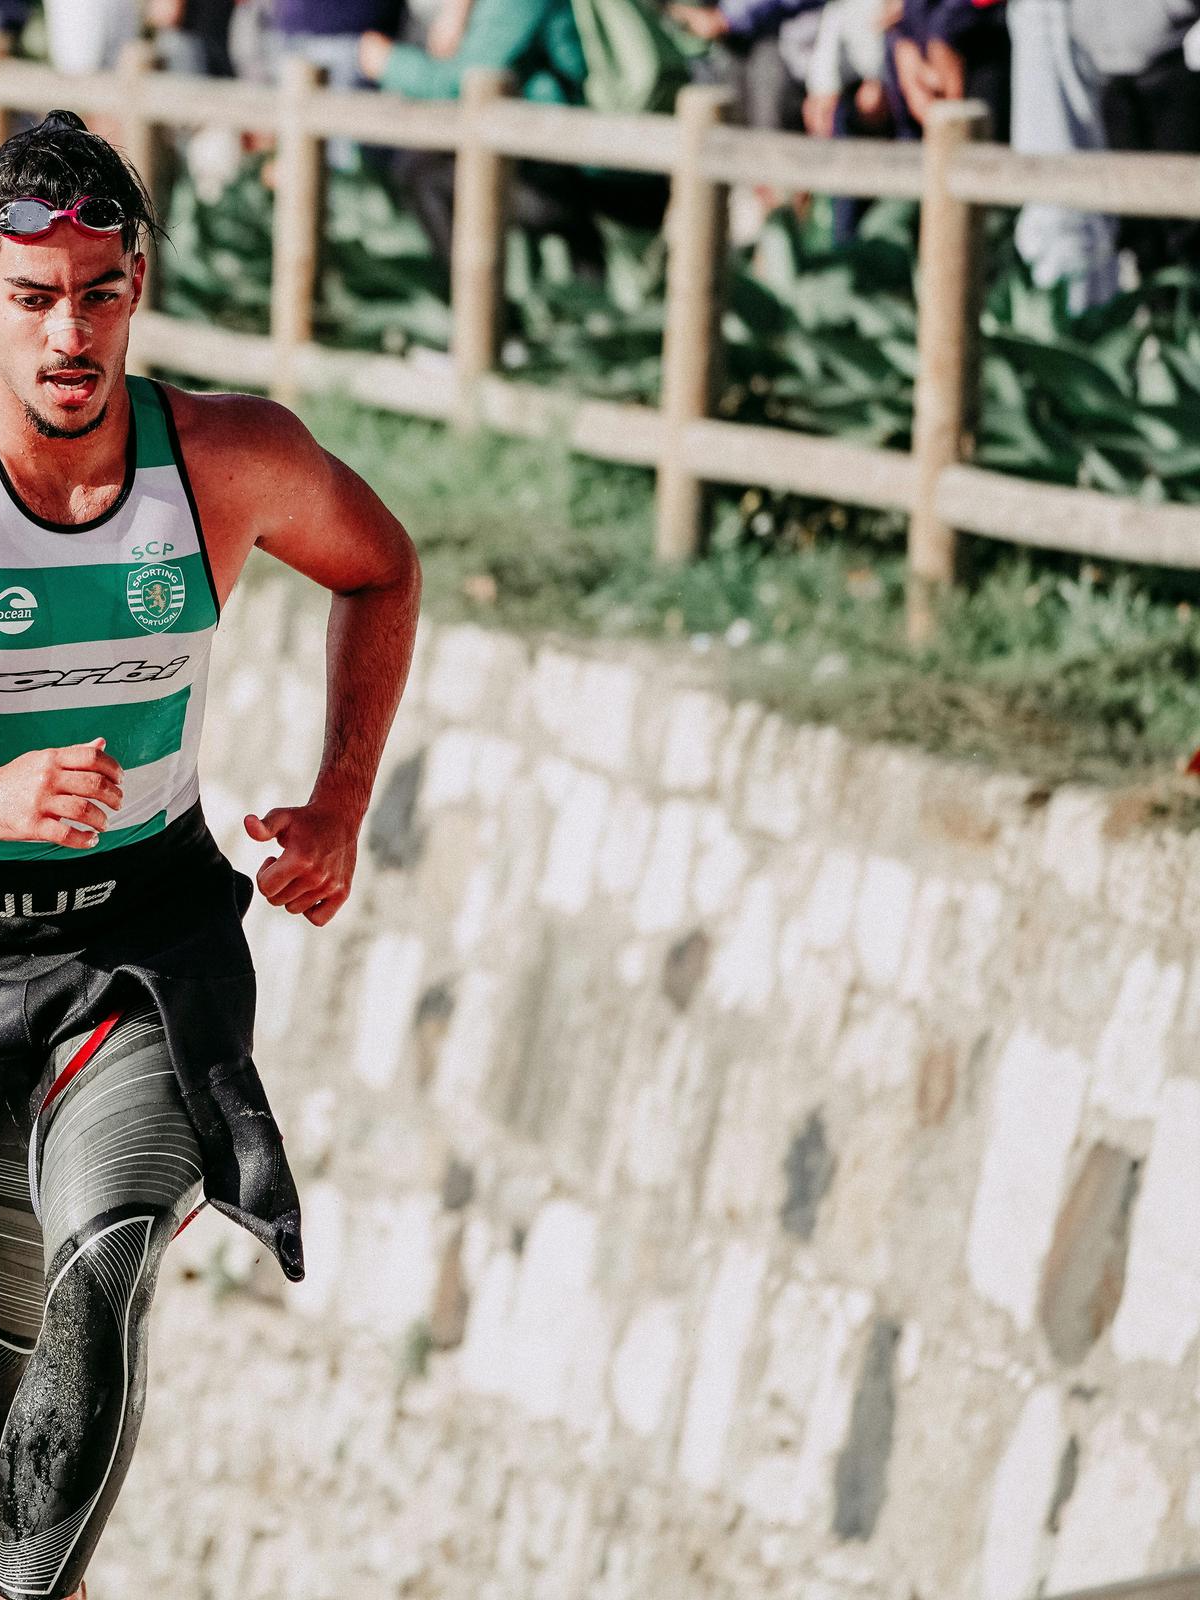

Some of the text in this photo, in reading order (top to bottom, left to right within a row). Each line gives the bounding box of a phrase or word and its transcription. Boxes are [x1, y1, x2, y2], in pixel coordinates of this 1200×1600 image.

[131, 541, 174, 560] SCP
[132, 568, 179, 588] SPORTING
[138, 611, 178, 626] PORTUGAL
